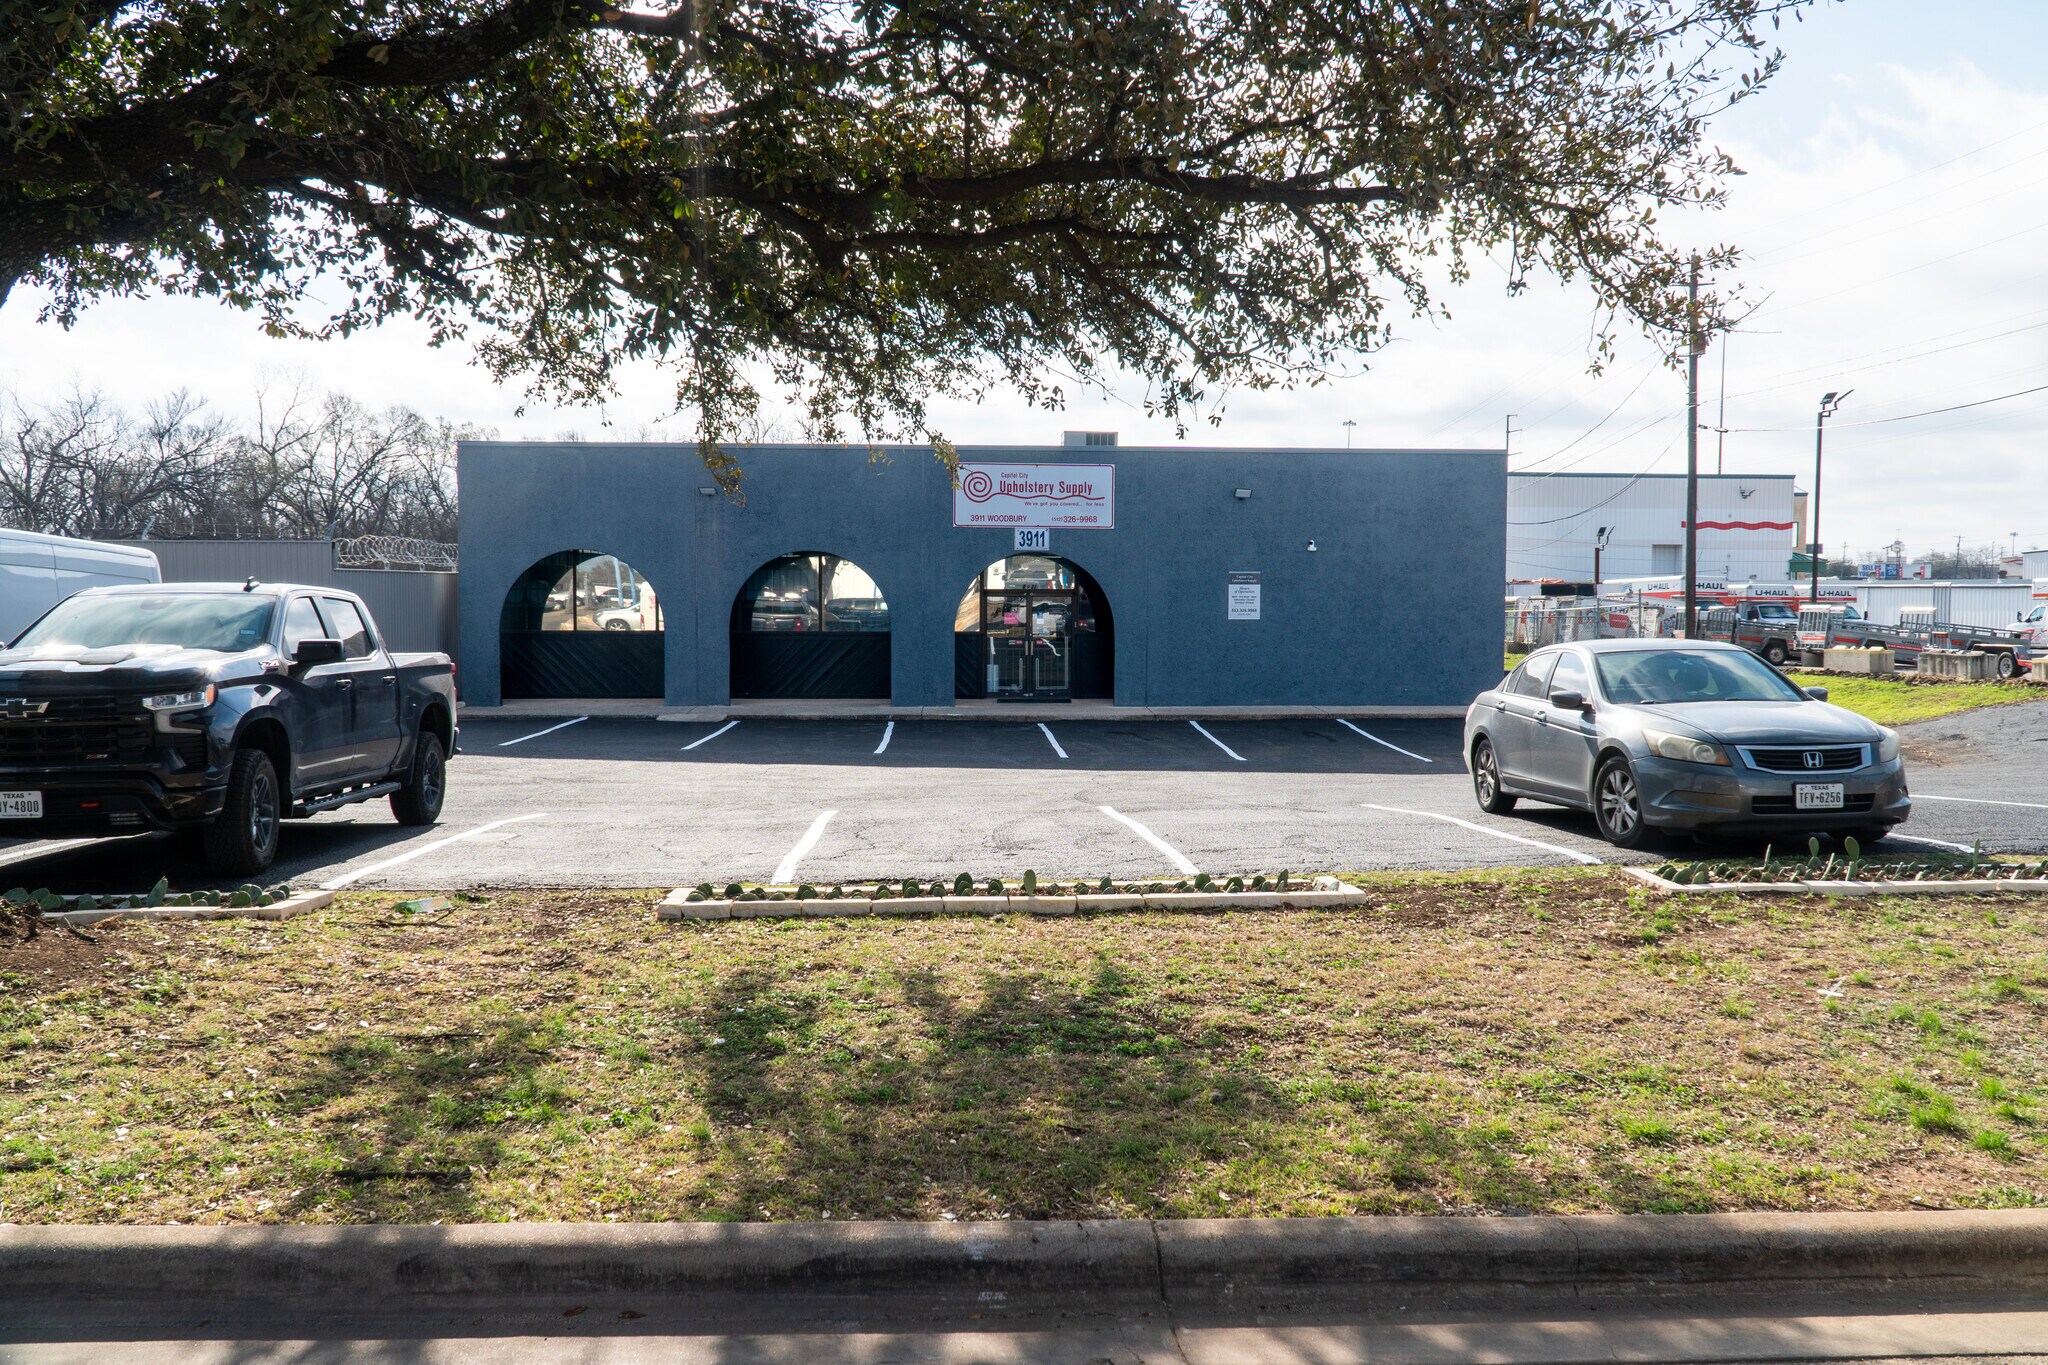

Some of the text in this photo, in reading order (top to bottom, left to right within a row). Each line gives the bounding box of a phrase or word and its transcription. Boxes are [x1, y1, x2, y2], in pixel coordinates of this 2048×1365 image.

[1000, 480, 1093, 496] Upholstery Supply
[970, 514, 985, 522] 3911
[1018, 530, 1045, 547] 3911
[1647, 583, 1670, 591] U-HAUL
